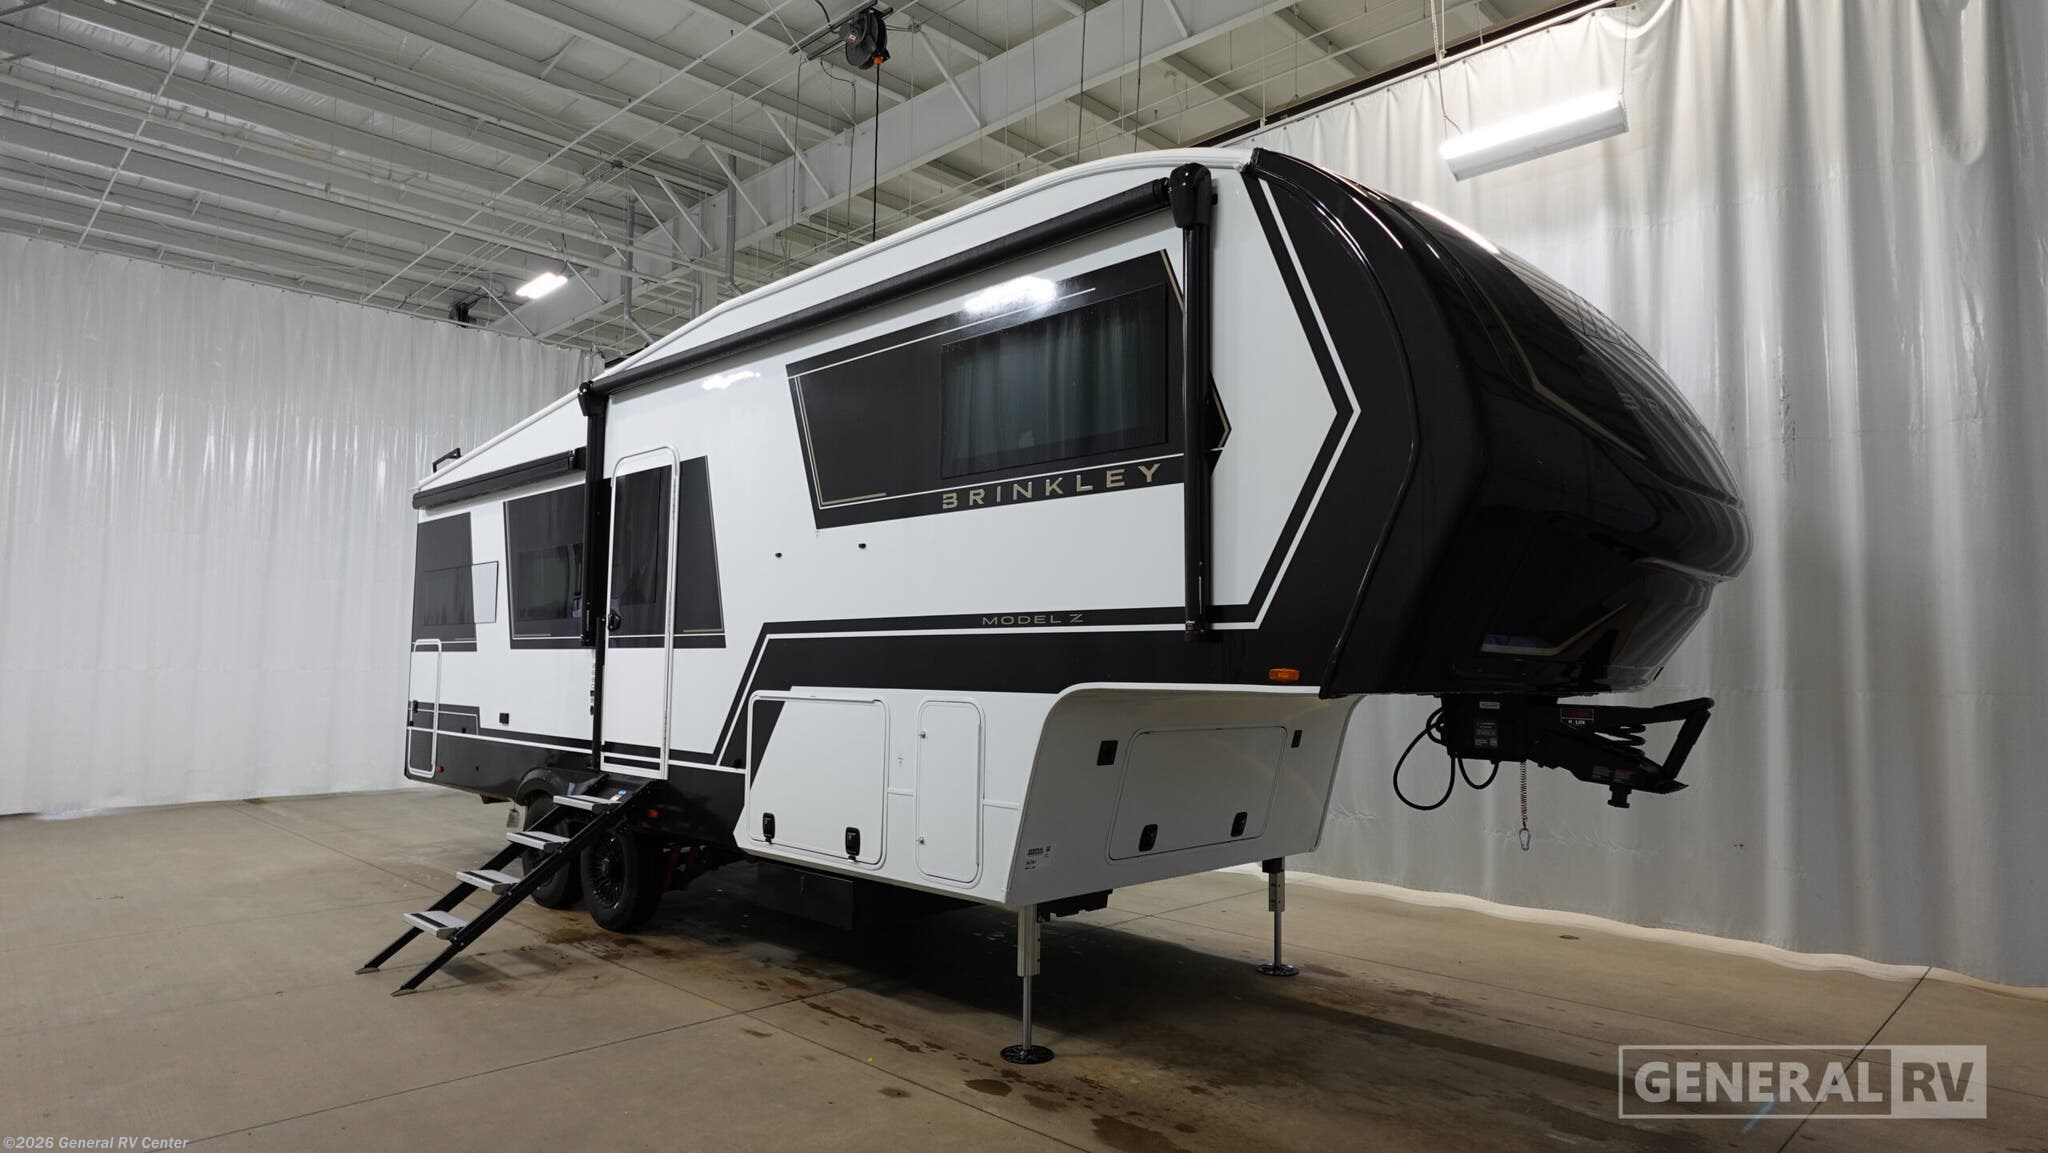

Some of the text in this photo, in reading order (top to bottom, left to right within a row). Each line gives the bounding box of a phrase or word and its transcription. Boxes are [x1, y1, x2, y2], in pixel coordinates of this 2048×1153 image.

[942, 463, 1160, 510] BRINKLEY
[982, 613, 1083, 626] MODEL Z
